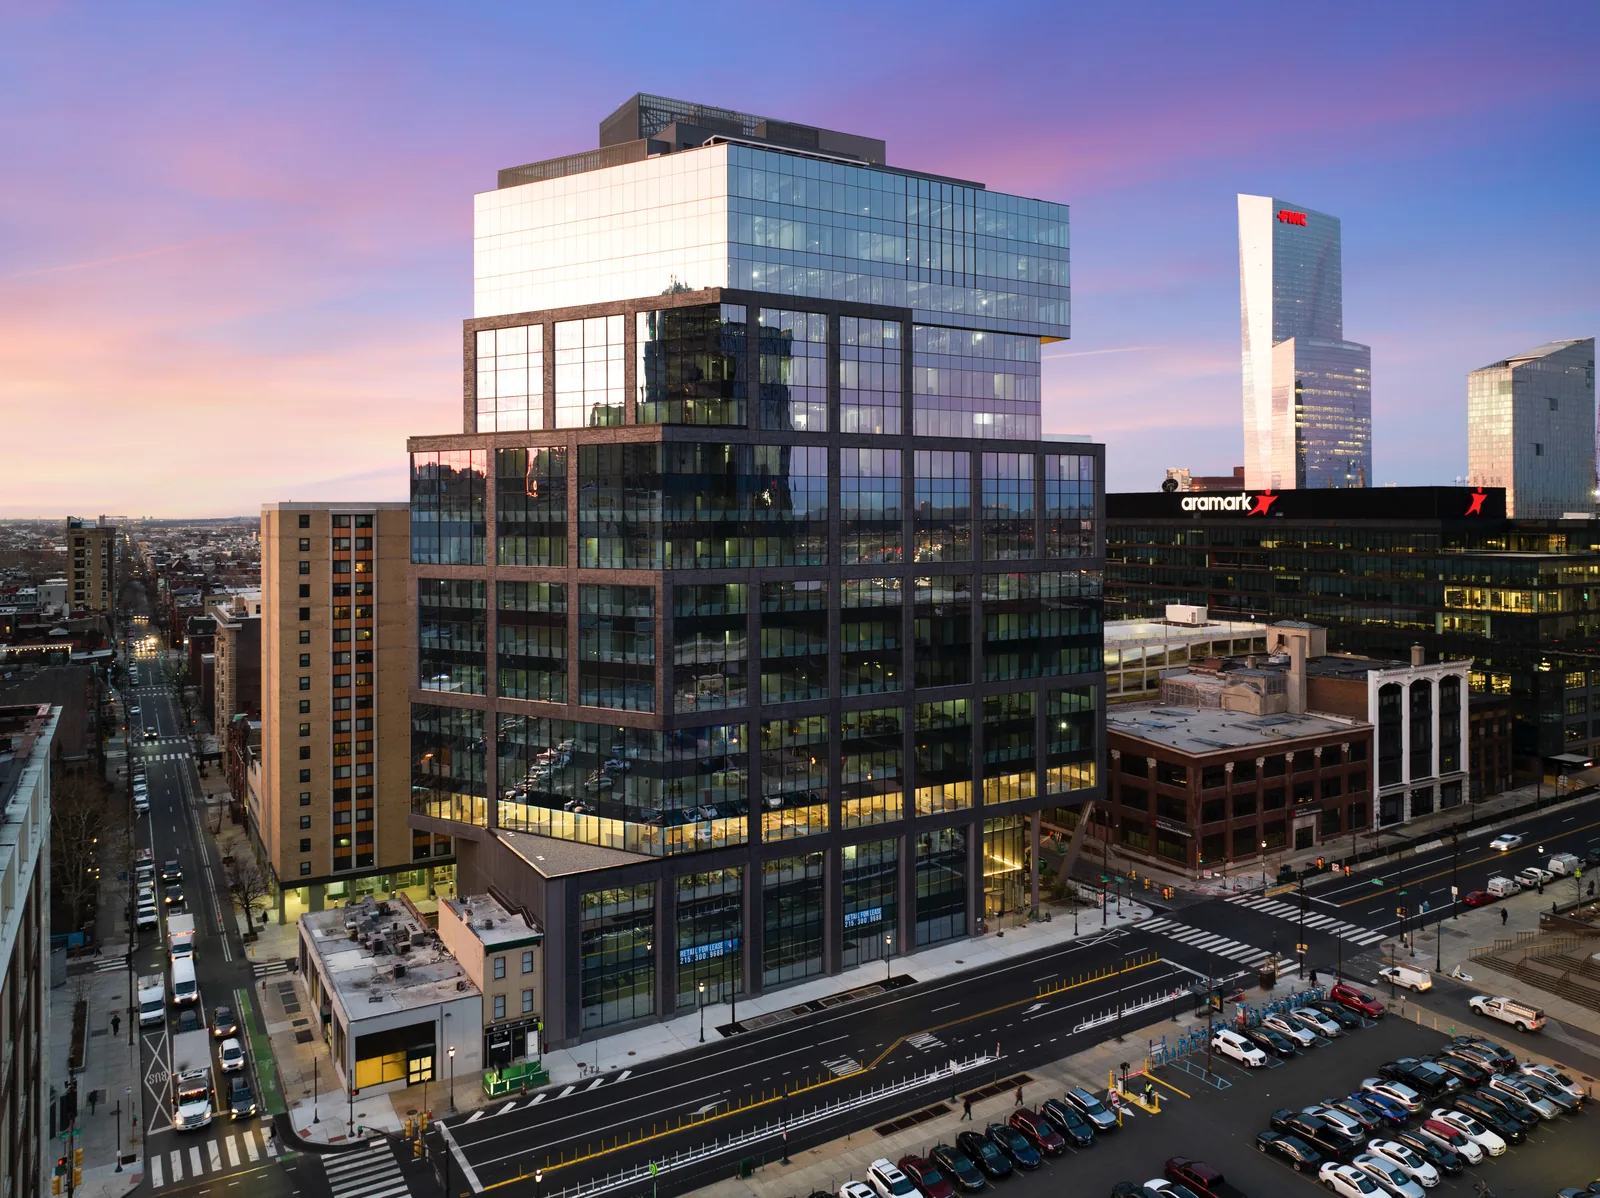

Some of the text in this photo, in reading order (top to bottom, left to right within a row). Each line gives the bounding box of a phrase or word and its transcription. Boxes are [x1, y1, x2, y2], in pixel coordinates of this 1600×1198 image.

[1277, 209, 1307, 227] FMC
[1181, 492, 1252, 511] aramark
[844, 912, 860, 922] RETAIL
[869, 907, 882, 915] LEASE
[679, 941, 724, 958] RETAIL FOR LEASE
[148, 1070, 167, 1085] BUS
